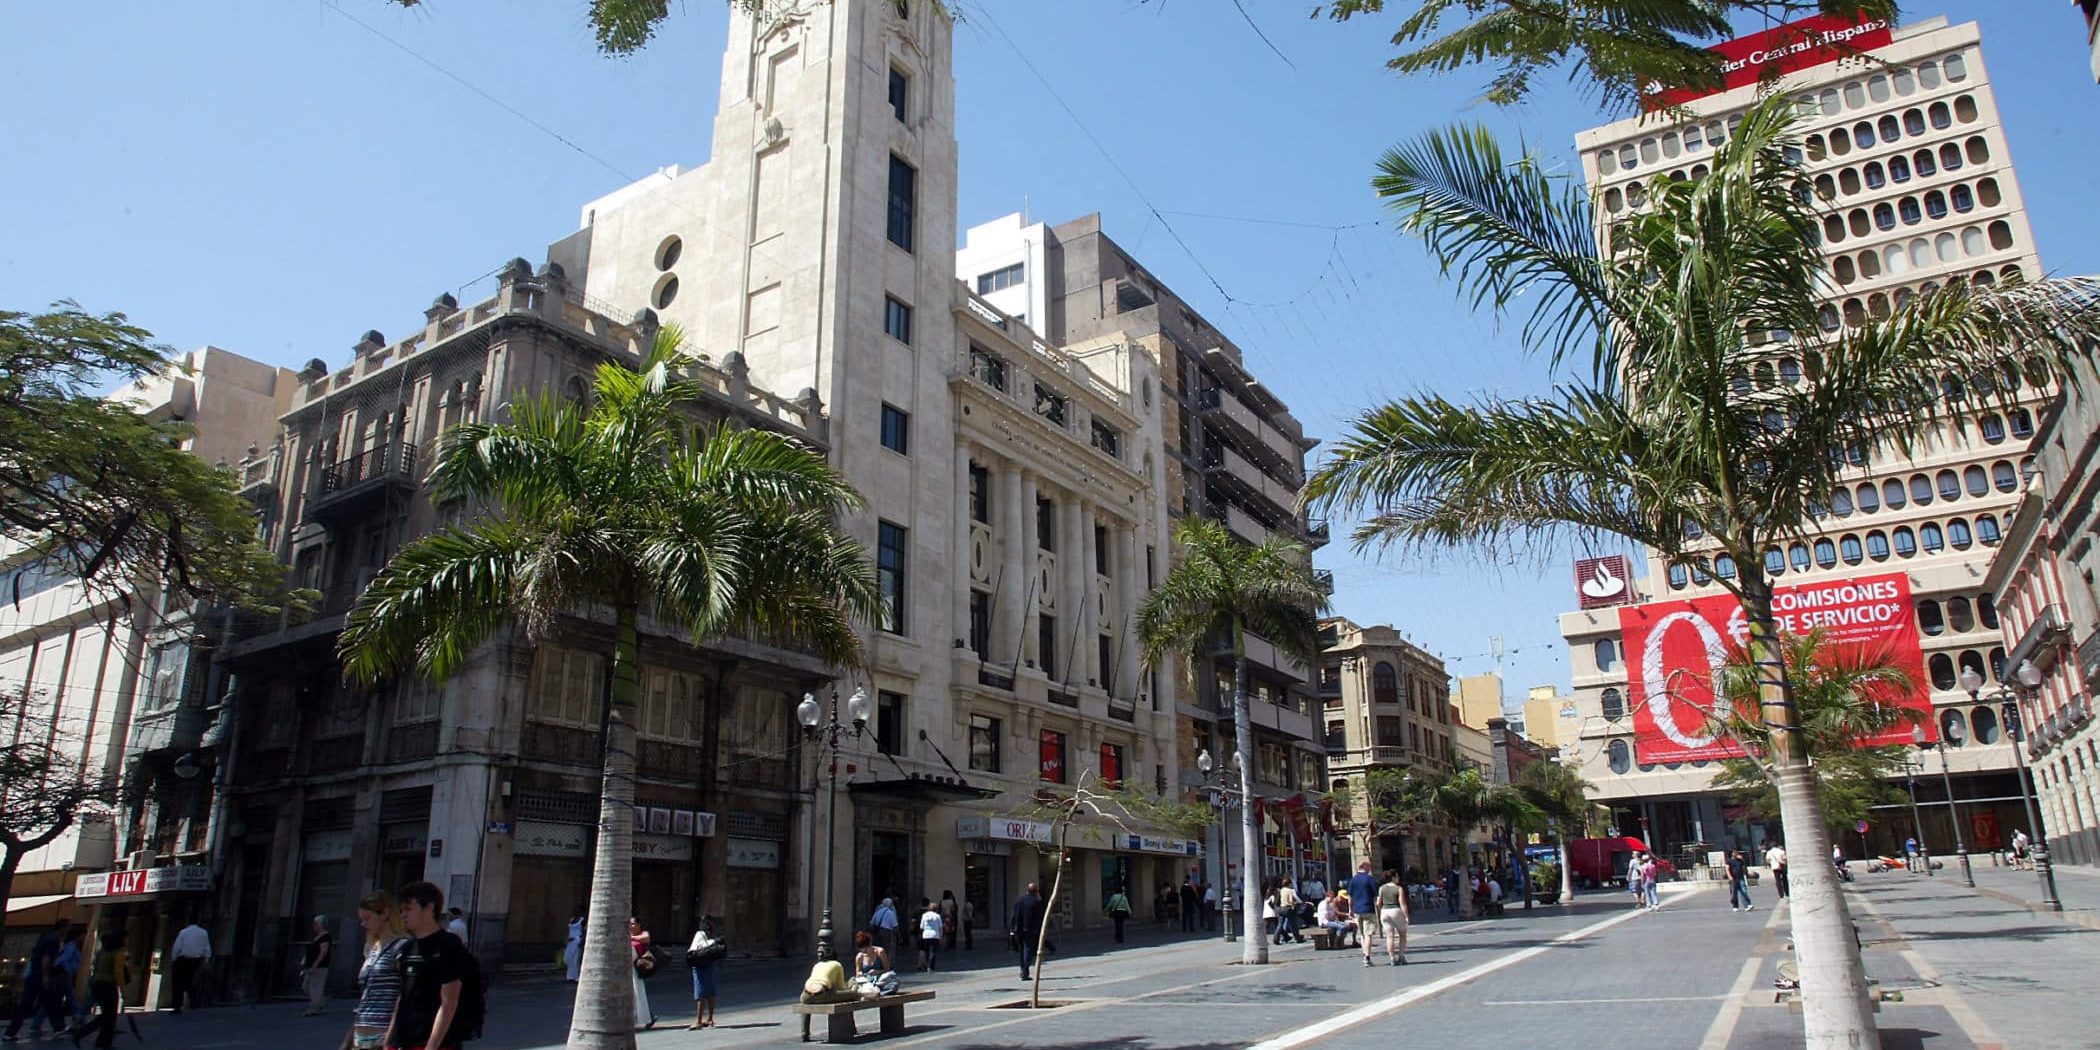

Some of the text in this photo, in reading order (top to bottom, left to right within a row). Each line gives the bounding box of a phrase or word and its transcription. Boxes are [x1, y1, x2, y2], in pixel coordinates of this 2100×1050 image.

[1770, 581, 1899, 612] COMISIONES
[1773, 614, 1797, 633] DE
[112, 872, 142, 893] LILY
